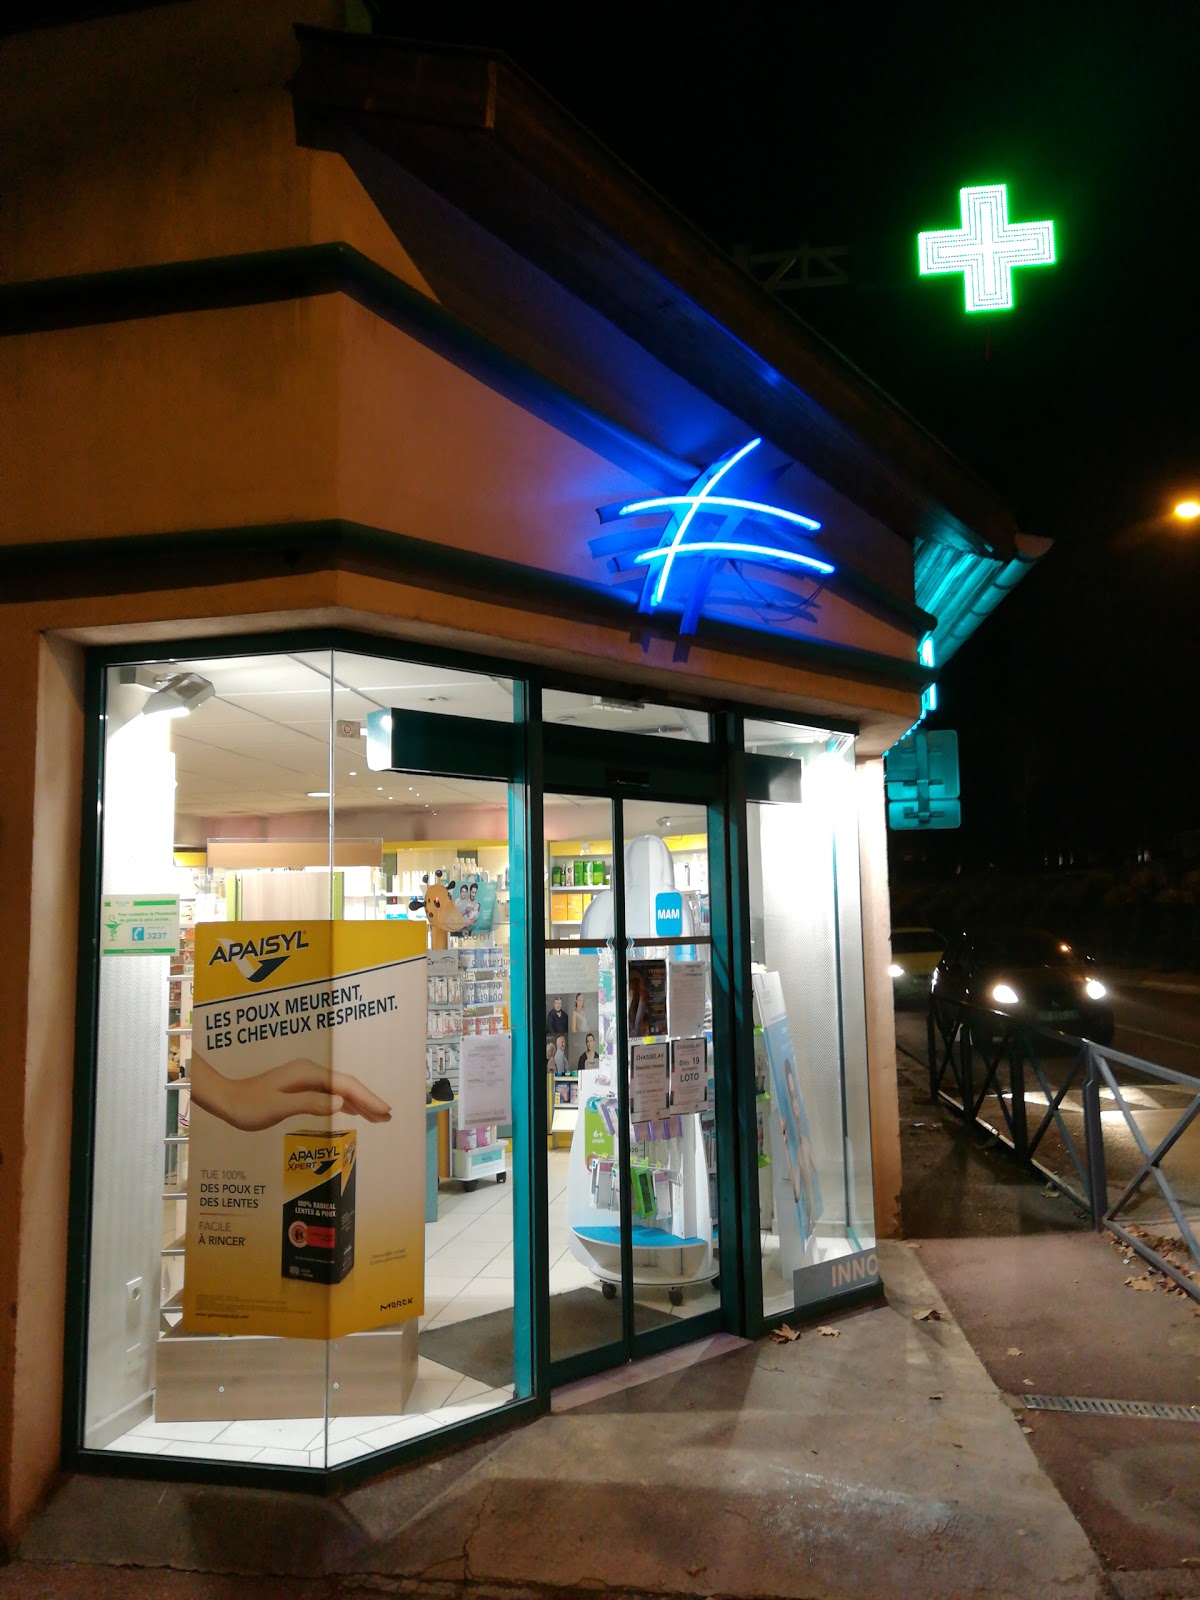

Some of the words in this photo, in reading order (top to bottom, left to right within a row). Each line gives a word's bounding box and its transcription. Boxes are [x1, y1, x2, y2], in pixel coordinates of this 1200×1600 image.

[657, 909, 680, 920] MAM
[147, 932, 167, 940] 3237
[208, 930, 309, 966] APAISYL
[206, 1011, 231, 1031] LES
[236, 1001, 281, 1024] POUX
[285, 984, 362, 1015] MEURENT,
[207, 1031, 232, 1051] LES
[237, 1016, 312, 1044] CHEVEUX
[316, 995, 398, 1029] RESPIRENT.
[636, 1053, 665, 1061] CHASSELAY
[692, 1056, 700, 1065] 19
[680, 1073, 700, 1083] LOTO
[593, 1130, 603, 1138] 6+
[288, 1146, 340, 1162] APAISYL
[287, 1161, 317, 1172] XPERT
[201, 1169, 219, 1180] TUE
[222, 1170, 246, 1181] 100%
[200, 1184, 219, 1193] DES
[222, 1184, 251, 1194] POUX
[254, 1185, 266, 1195] ET
[200, 1197, 219, 1207] DES
[222, 1198, 259, 1209] LENTES
[199, 1221, 231, 1232] FACILE
[198, 1233, 206, 1245] À
[208, 1235, 246, 1246] RINCER
